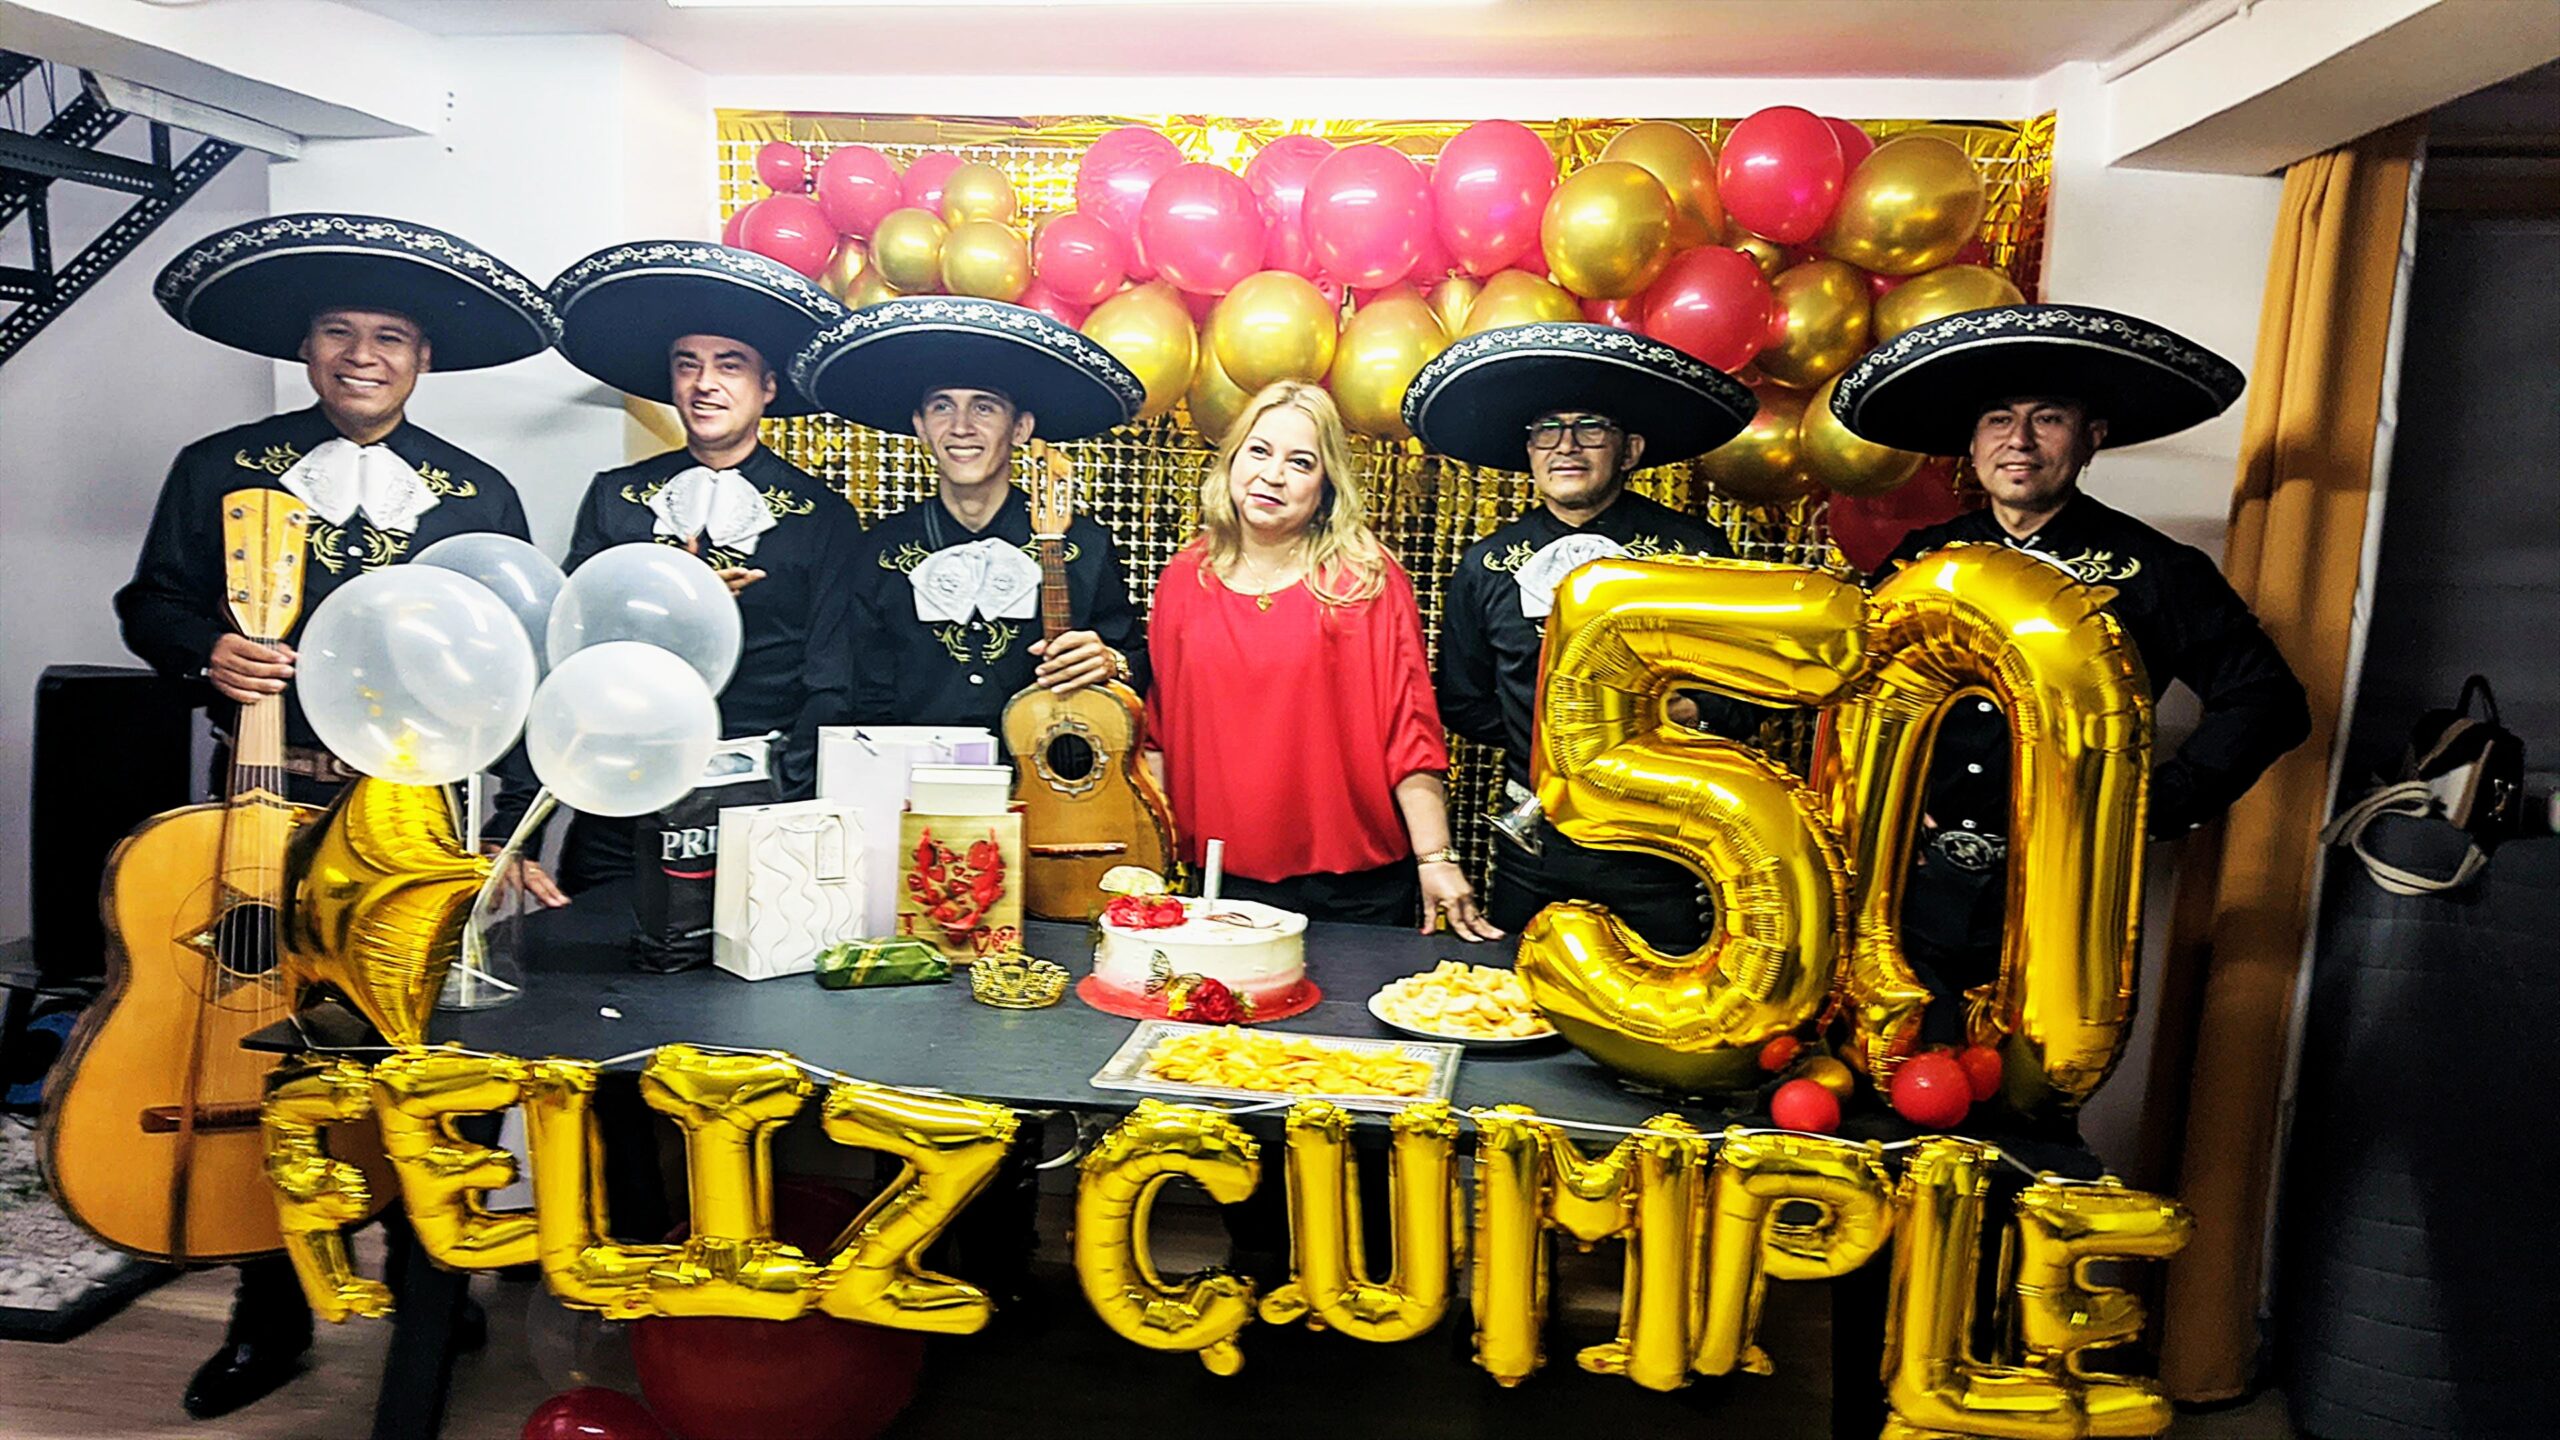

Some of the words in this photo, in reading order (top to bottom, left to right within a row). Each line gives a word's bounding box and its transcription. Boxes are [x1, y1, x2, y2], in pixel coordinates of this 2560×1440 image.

[1515, 541, 2153, 1098] 50
[261, 1043, 1020, 1335] FELIZ
[1074, 1098, 2197, 1440] CUMPLE
